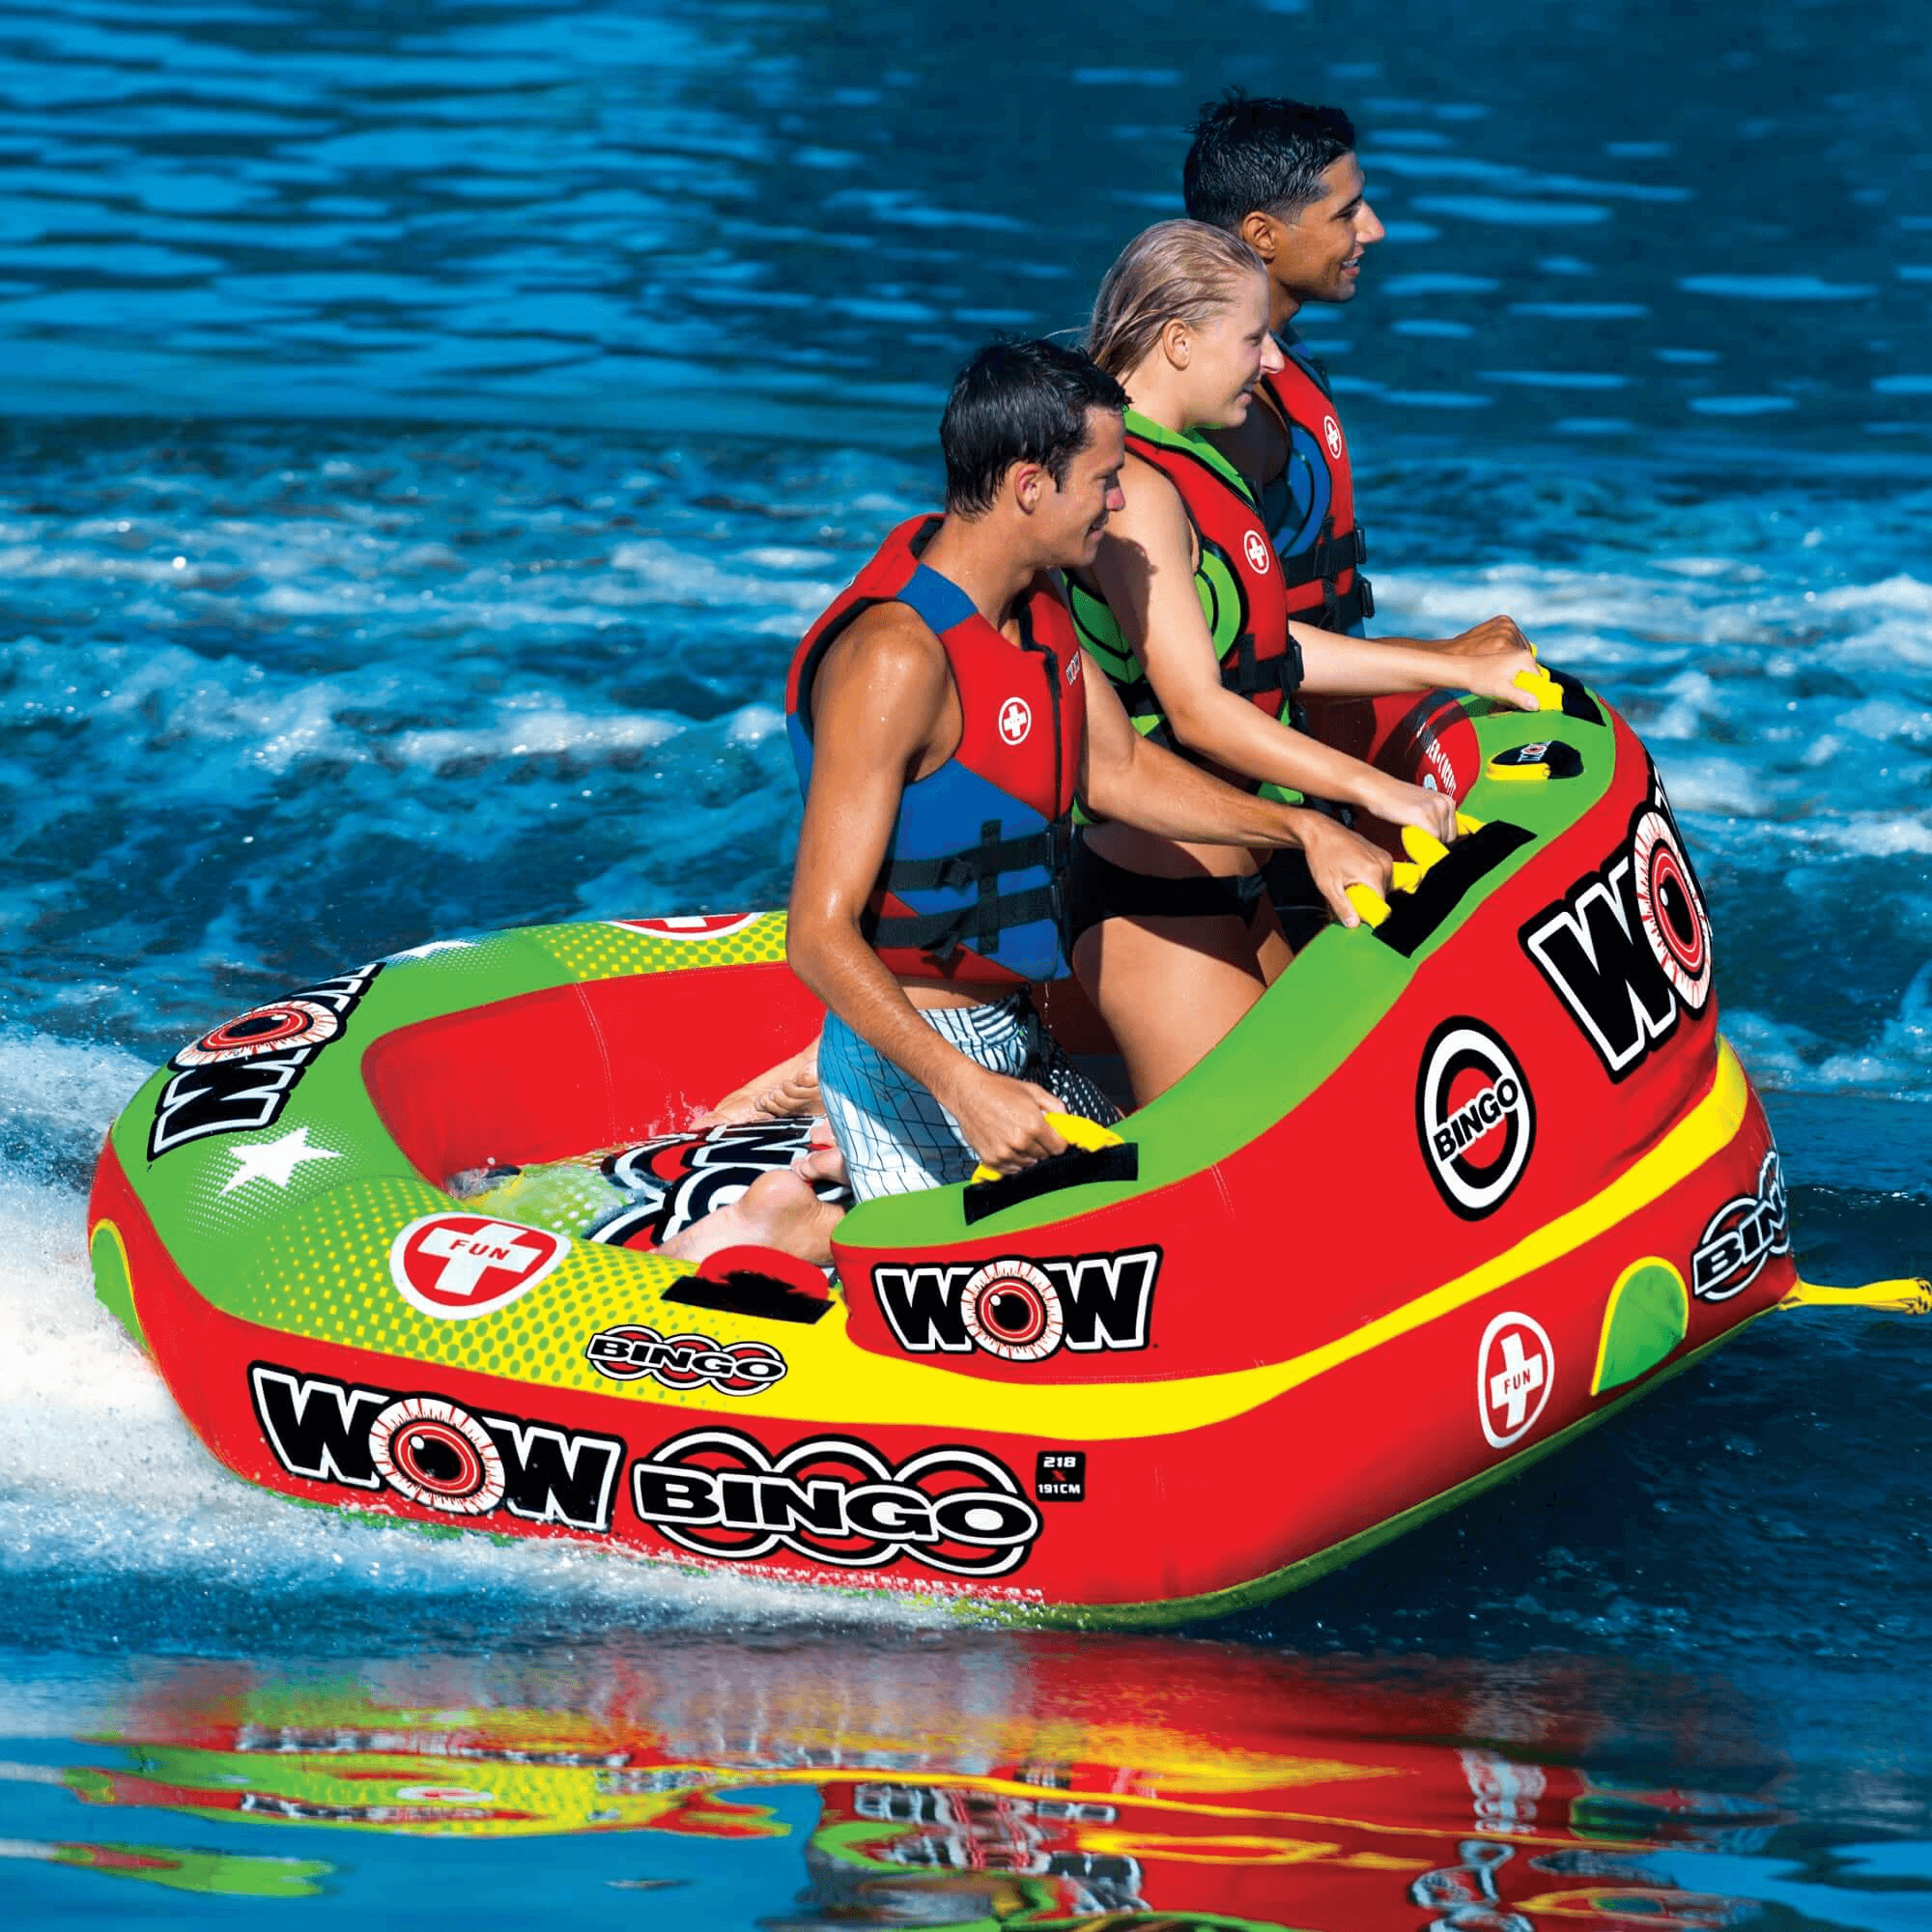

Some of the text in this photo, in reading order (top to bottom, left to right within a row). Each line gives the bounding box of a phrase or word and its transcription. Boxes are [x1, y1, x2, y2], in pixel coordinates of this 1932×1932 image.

[1432, 1076, 1520, 1163] BINGO
[447, 1237, 511, 1262] FUN
[1691, 1180, 1786, 1295] BIN
[870, 1243, 1164, 1363] WOW
[585, 1330, 788, 1384] BINGO
[1503, 1368, 1531, 1395] FUN
[247, 1360, 1044, 1550] WOW BINGO
[1043, 1456, 1076, 1467] 218
[1037, 1484, 1081, 1494] 191CM
